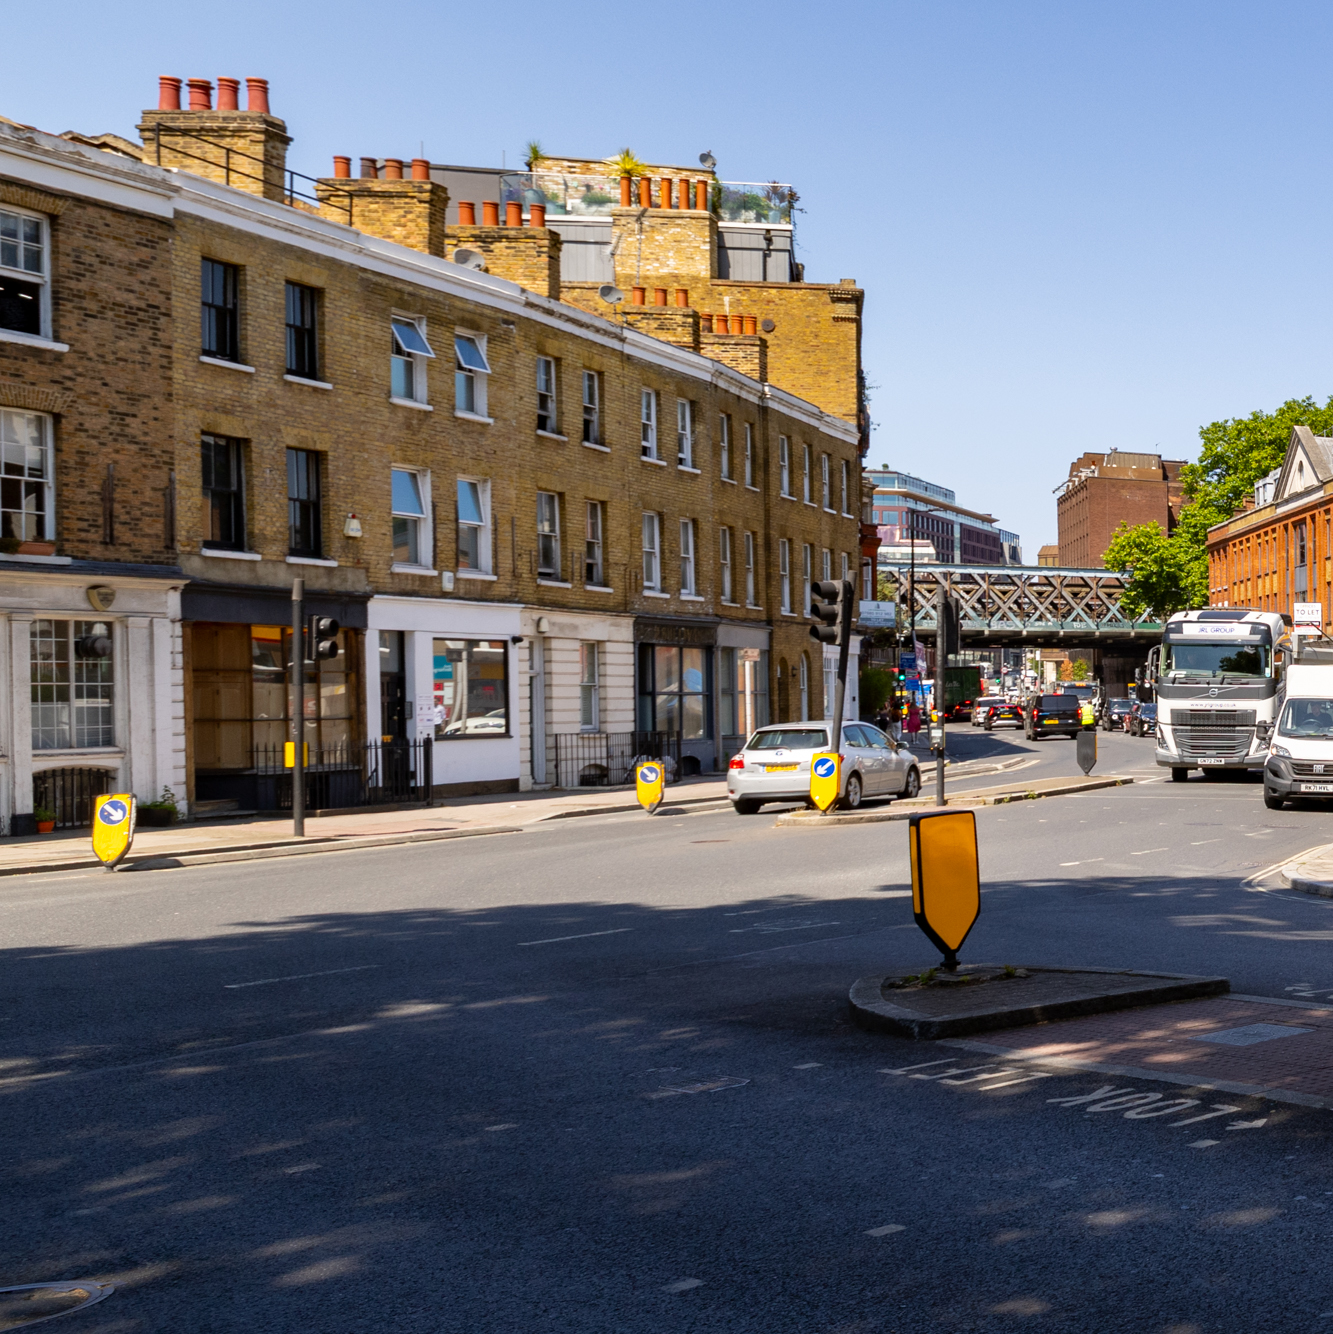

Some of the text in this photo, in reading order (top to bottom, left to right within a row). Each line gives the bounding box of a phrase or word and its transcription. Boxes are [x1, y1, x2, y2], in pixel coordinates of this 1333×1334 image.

[1313, 764, 1325, 773] FIAT
[878, 1058, 1242, 1127] LOOK LEFT
